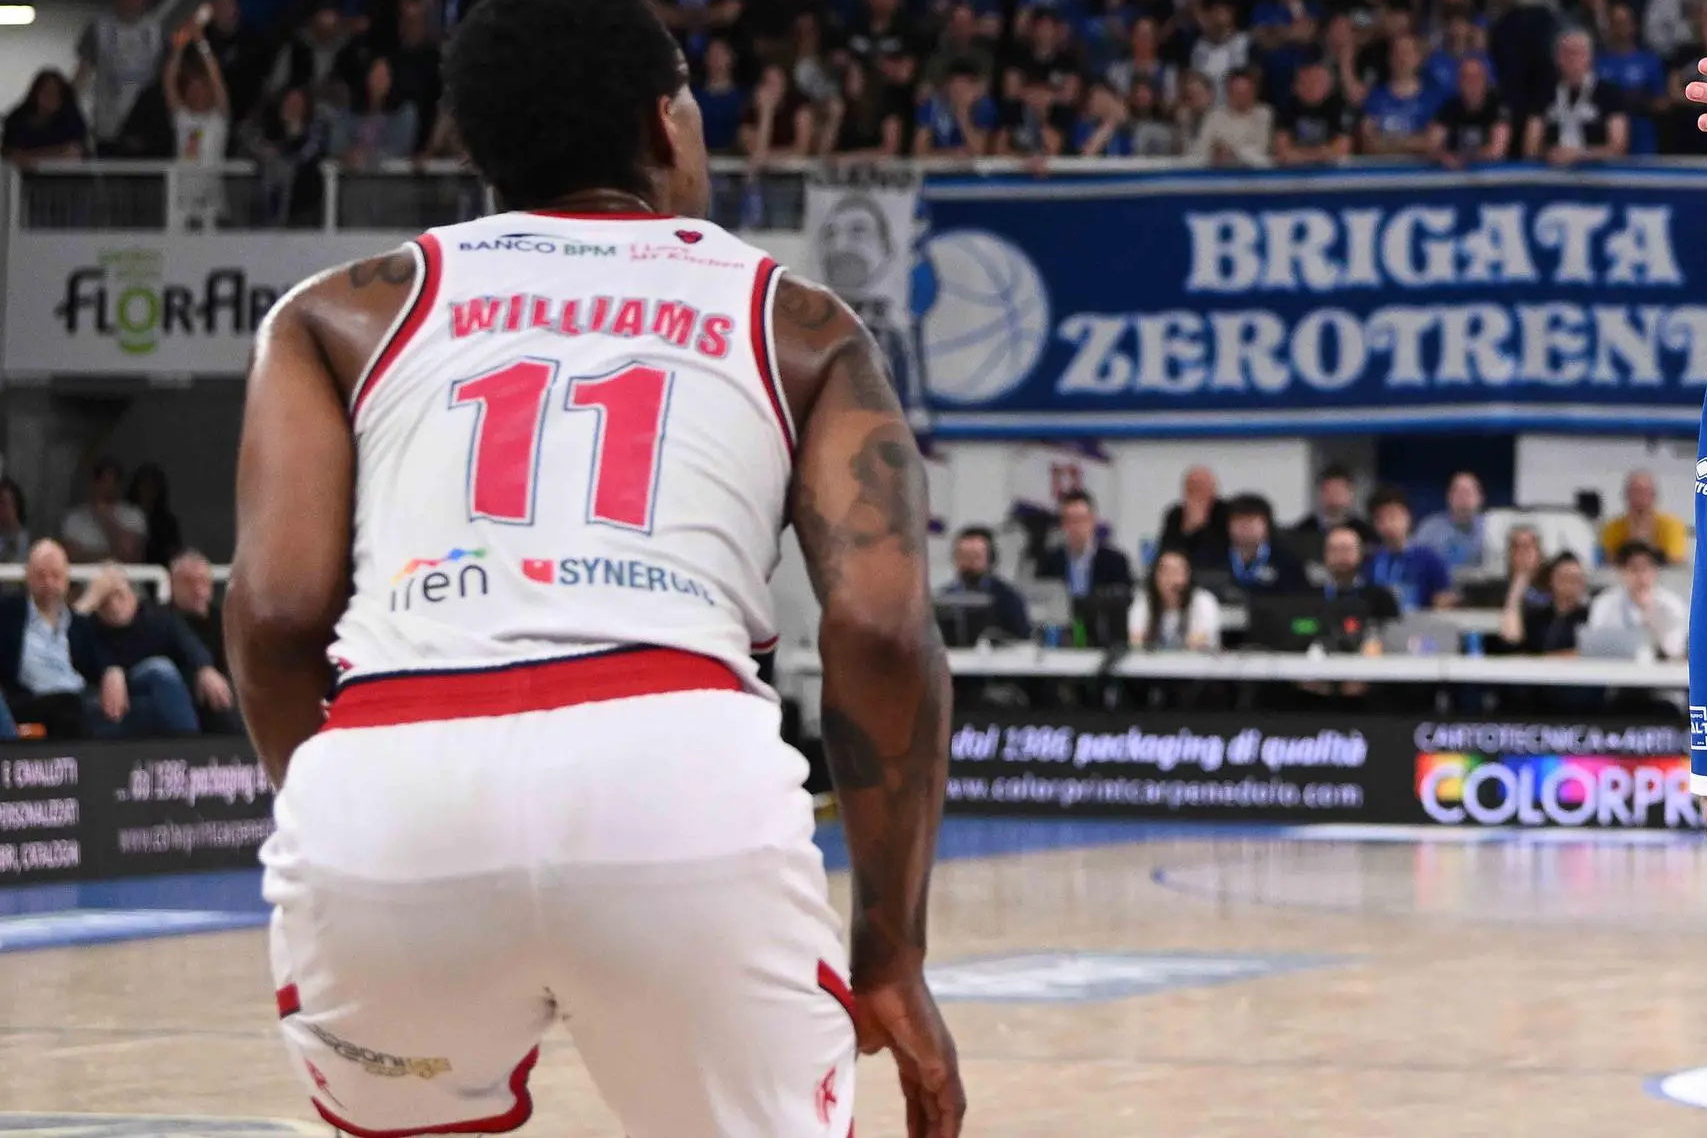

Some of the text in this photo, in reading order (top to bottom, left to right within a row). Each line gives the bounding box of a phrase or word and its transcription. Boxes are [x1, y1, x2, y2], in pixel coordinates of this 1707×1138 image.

[459, 238, 617, 257] BANCO BPM
[1186, 202, 1685, 296] BRIGATA
[448, 293, 735, 360] WILLIAMS
[448, 355, 675, 535] 11
[1073, 725, 1225, 771] packaging
[1226, 727, 1262, 765] di
[1420, 761, 1703, 825] COLORPR
